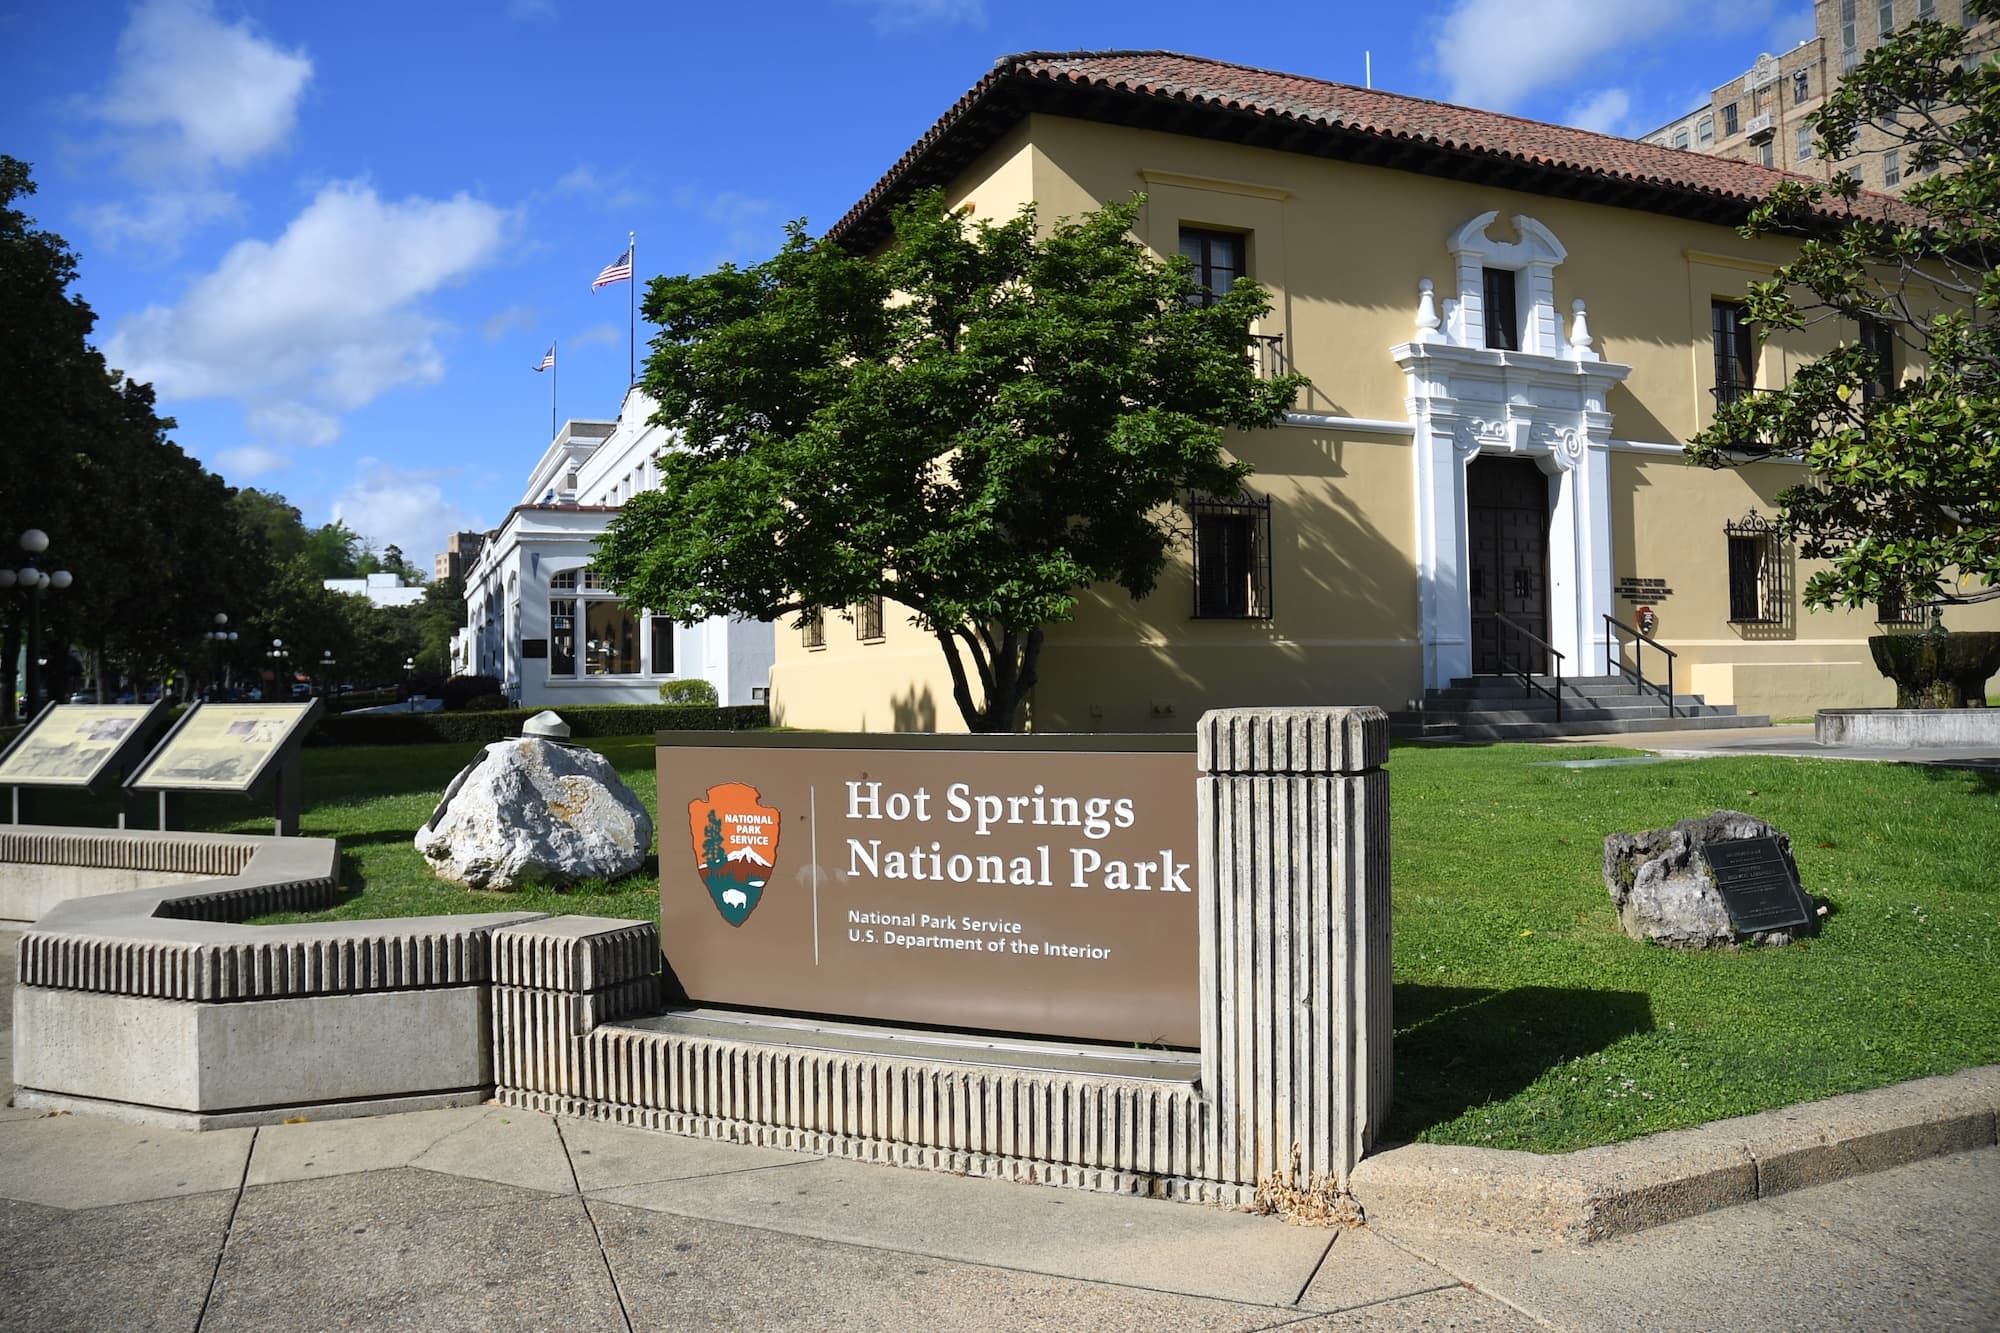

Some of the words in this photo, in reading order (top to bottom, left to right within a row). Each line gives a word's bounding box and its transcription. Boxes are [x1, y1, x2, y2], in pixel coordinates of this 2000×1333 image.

[724, 813, 773, 825] NATIONAL
[846, 781, 931, 822] Hot
[946, 784, 1135, 840] Springs
[729, 834, 769, 846] SERVICE
[736, 824, 762, 835] PARK
[846, 838, 1053, 887] National
[1069, 847, 1193, 893] Park
[848, 909, 916, 928] National
[920, 913, 957, 931] Park
[961, 916, 1022, 934] Service
[848, 928, 879, 944] U.S.
[883, 930, 983, 952] Department
[986, 936, 1006, 953] of
[1009, 938, 1040, 955] the
[1043, 941, 1111, 960] Interior
